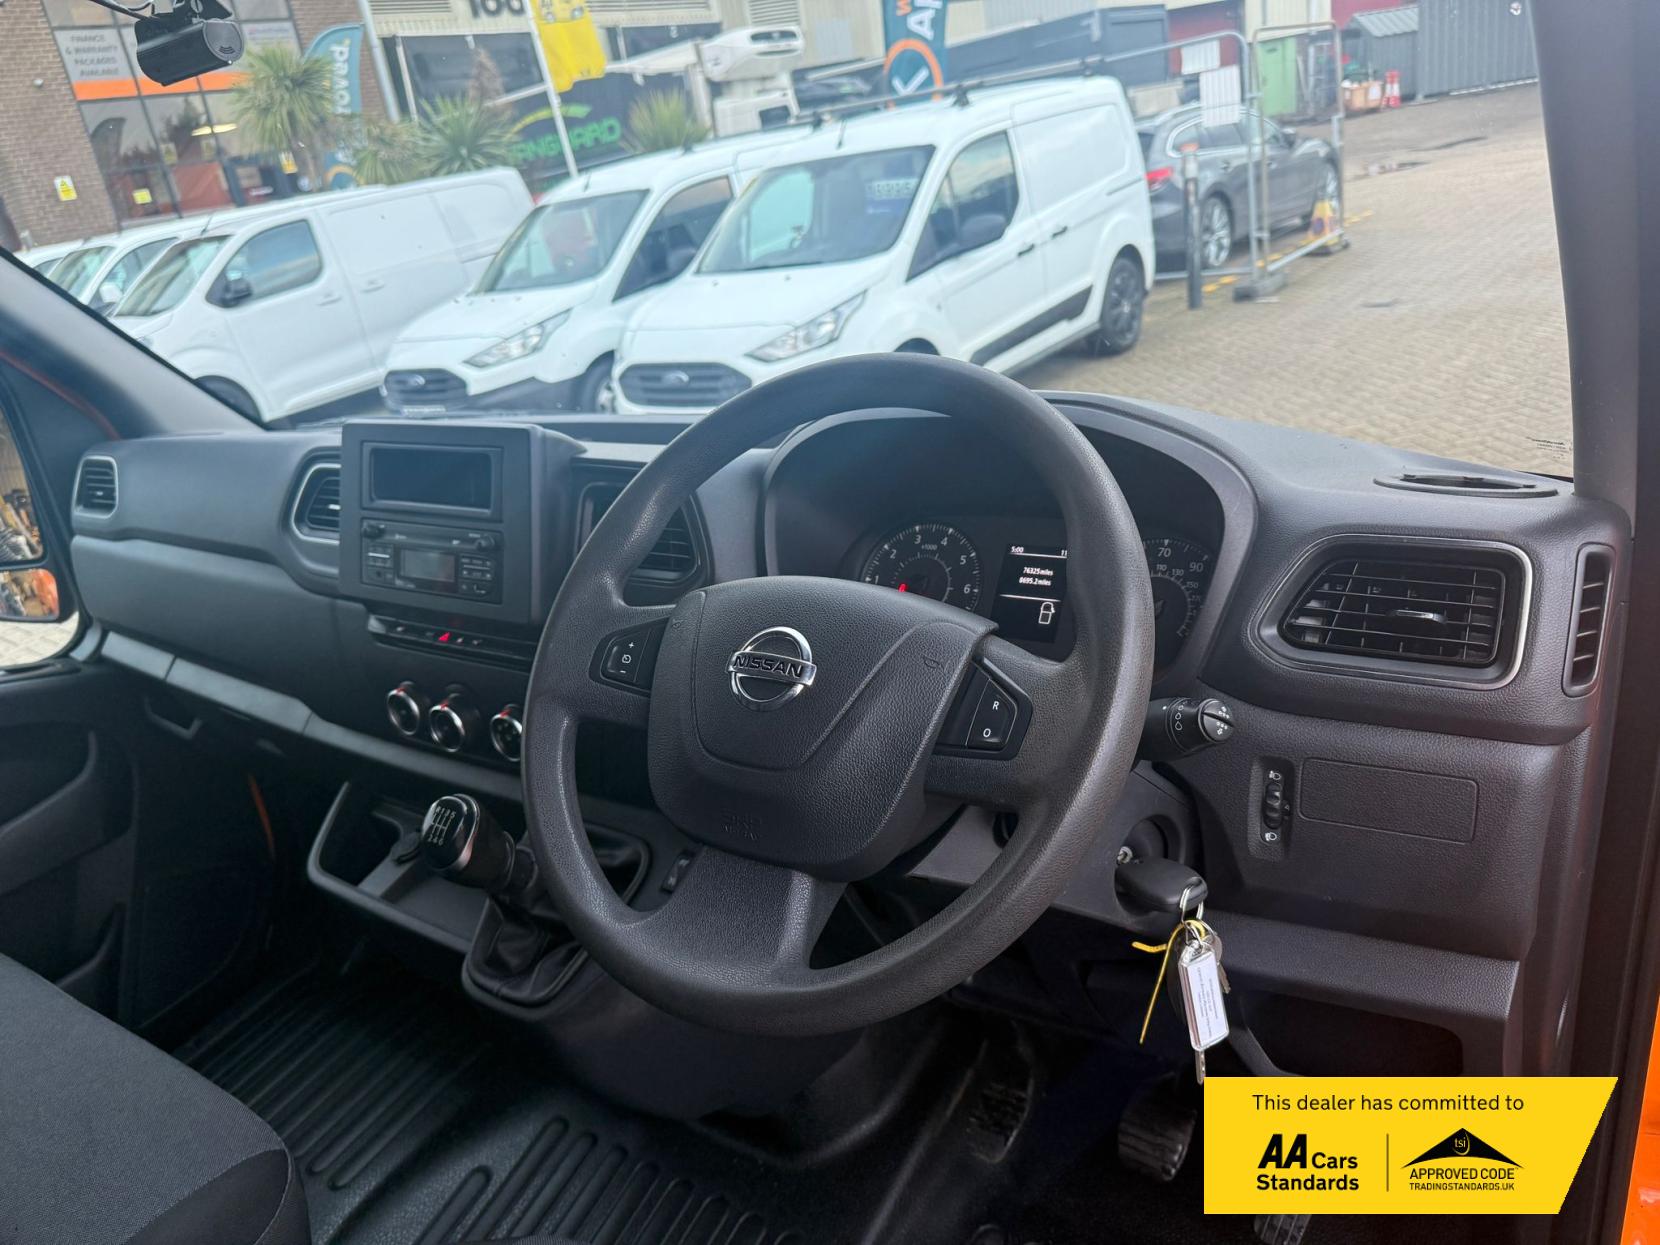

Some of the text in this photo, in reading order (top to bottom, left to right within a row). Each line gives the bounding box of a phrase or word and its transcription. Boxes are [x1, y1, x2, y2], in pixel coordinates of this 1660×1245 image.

[914, 535, 921, 544] 3
[941, 537, 948, 546] 4
[889, 549, 897, 559] 2
[1158, 547, 1172, 558] 70
[960, 555, 967, 565] 5
[1189, 562, 1204, 573] 90
[963, 584, 971, 594] 6
[733, 655, 804, 679] NISSAN
[992, 701, 1000, 710] R
